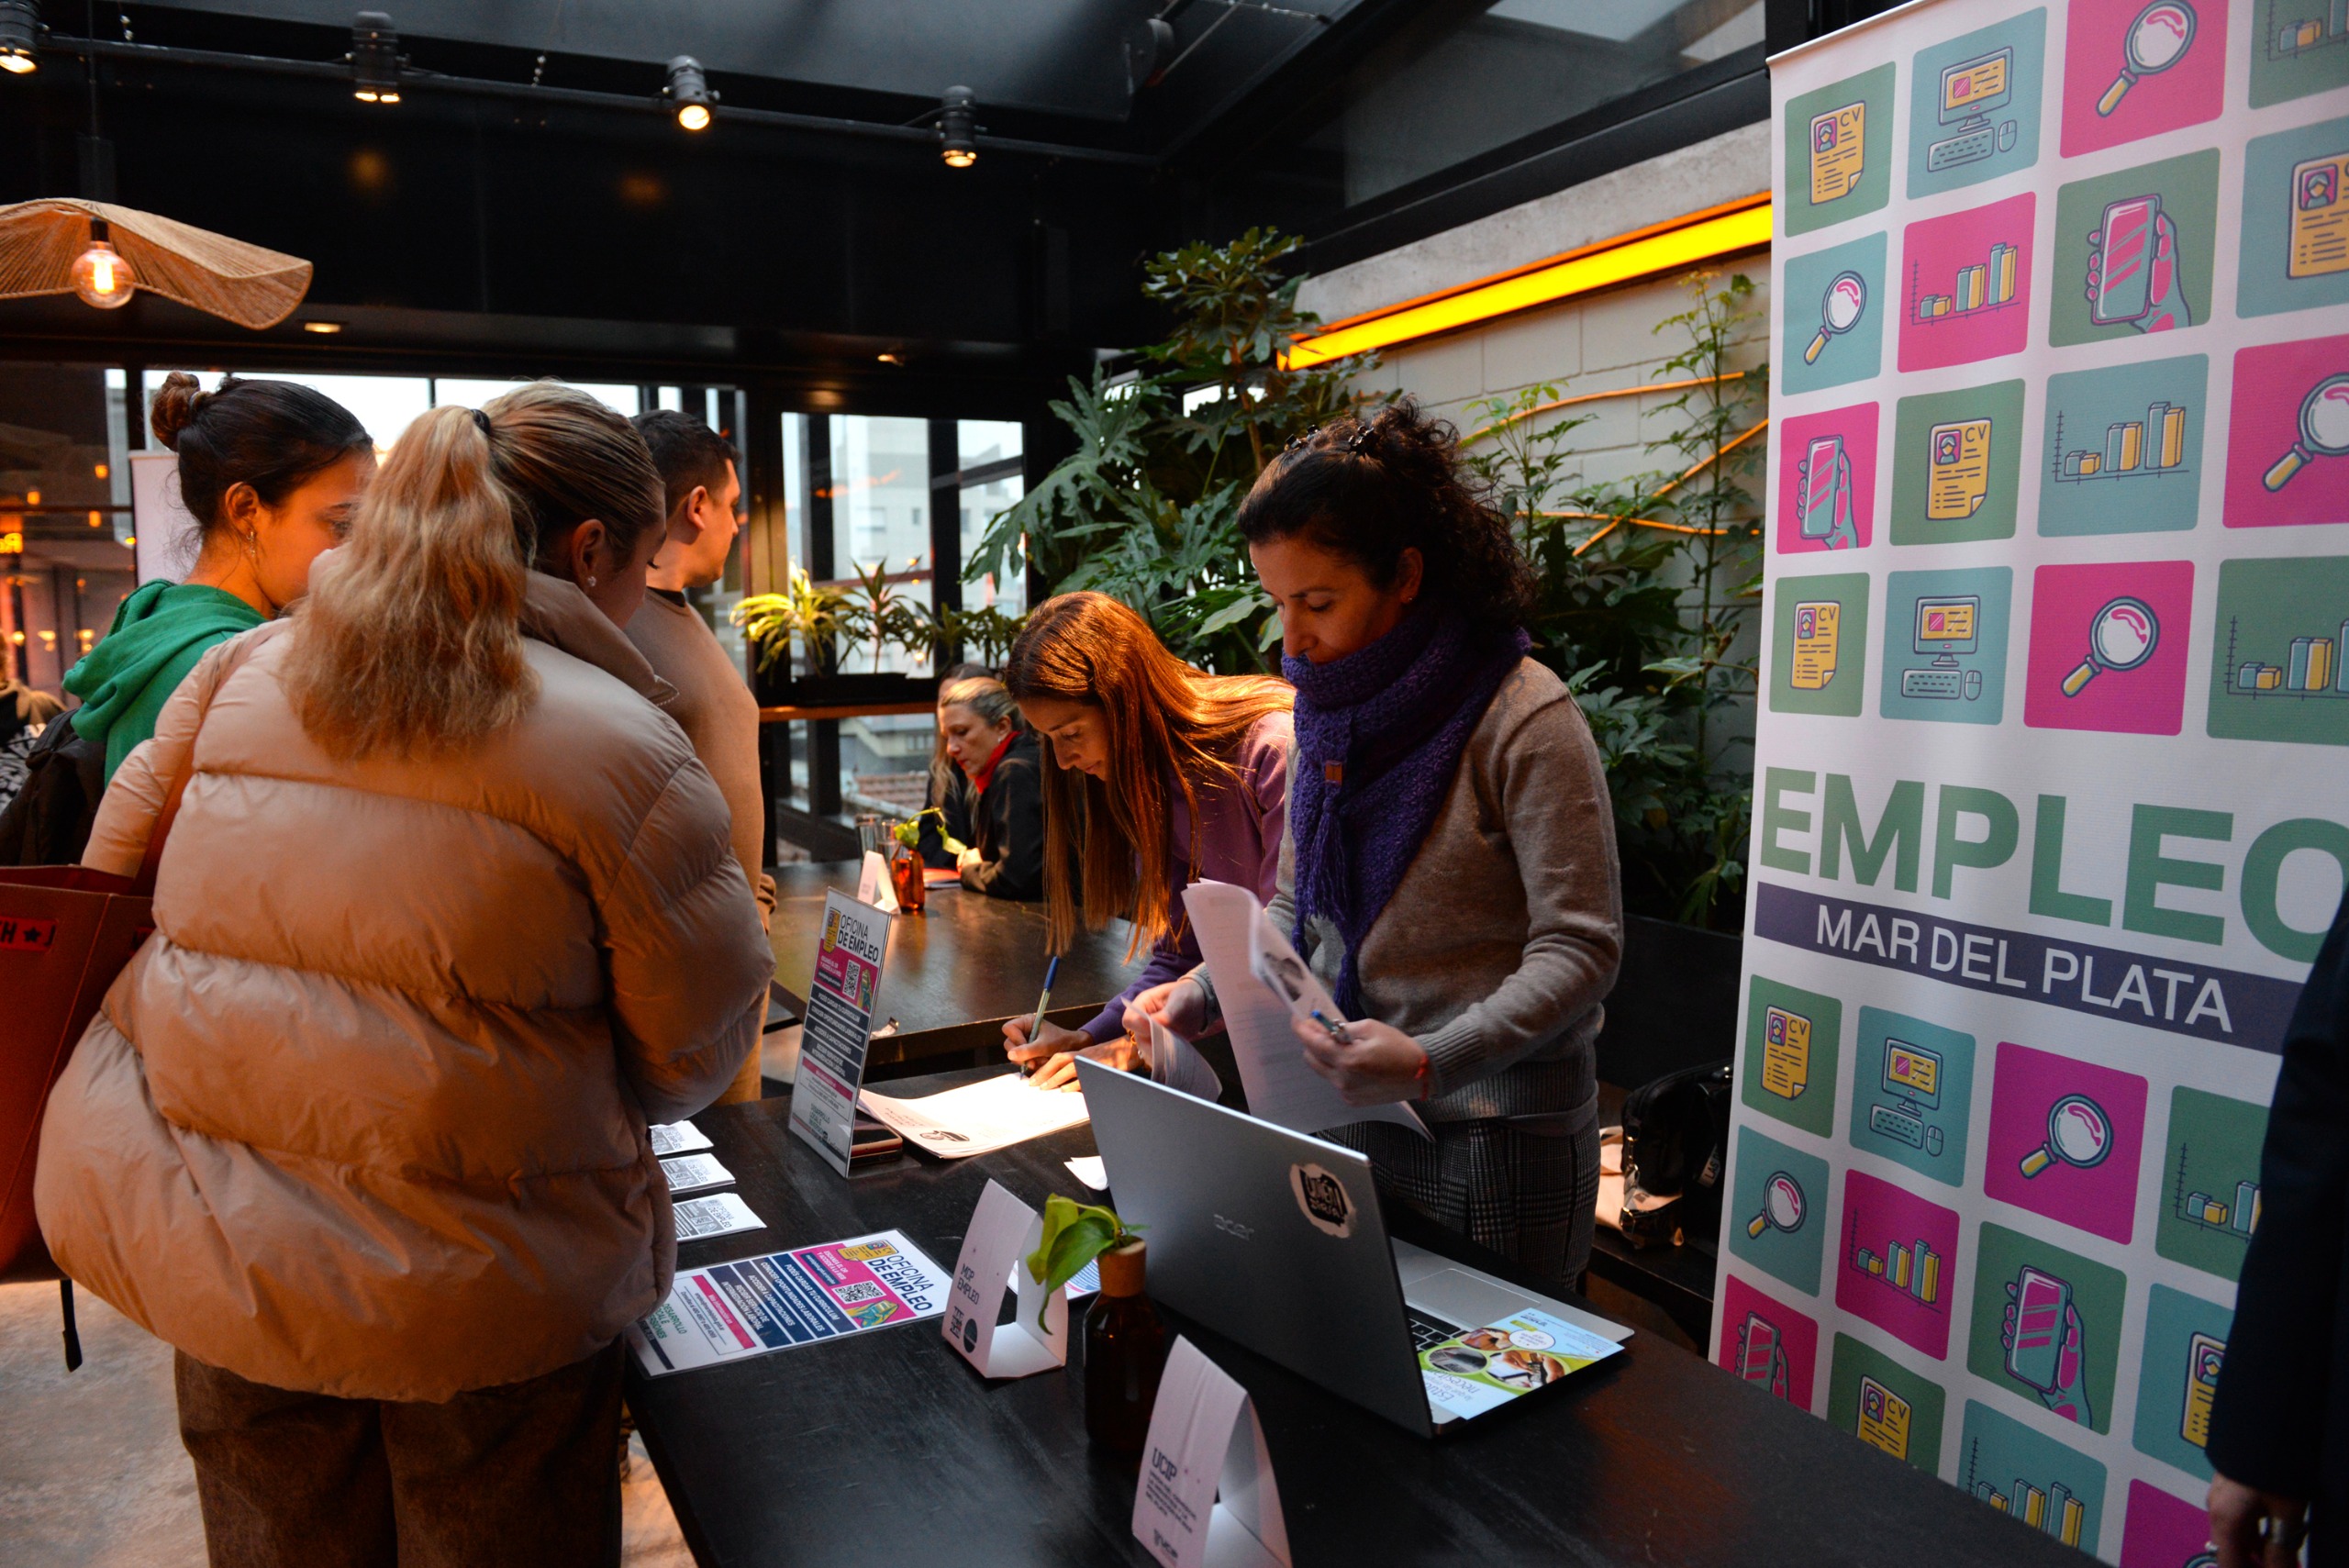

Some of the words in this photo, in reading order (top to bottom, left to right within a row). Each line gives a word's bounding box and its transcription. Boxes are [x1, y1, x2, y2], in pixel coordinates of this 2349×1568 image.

[1840, 106, 1861, 128] CV
[1965, 424, 1987, 443] CV
[1818, 606, 1837, 622] CV
[1760, 766, 2349, 964] EMPLEO
[840, 913, 869, 940] OFICINA
[838, 929, 848, 947] DE
[848, 934, 879, 962] EMPLEO
[1816, 904, 1920, 964] MAR
[1930, 927, 2027, 989] DEL
[2042, 948, 2233, 1033] PLATA
[1788, 1018, 1808, 1036] CV
[866, 1258, 893, 1272] DE
[885, 1254, 937, 1291] OFICINA
[794, 1275, 813, 1290] CARGAR
[879, 1271, 933, 1311] EMPLEO
[957, 1277, 980, 1305] EMPLEO
[744, 1298, 765, 1317] SERVICIO
[747, 1274, 767, 1291] ACCEDER
[763, 1294, 796, 1326] CAPACITACIONES
[759, 1262, 781, 1279] CONOCER
[773, 1278, 807, 1308] OPORTUNIDADES
[798, 1307, 826, 1331] LABORALES
[646, 1316, 668, 1339] ERSIONES
[661, 1303, 688, 1334] DESARROLLO
[743, 1311, 764, 1329] LABORAL
[1887, 1399, 1907, 1419] CV
[1152, 1448, 1177, 1482] UCIP
